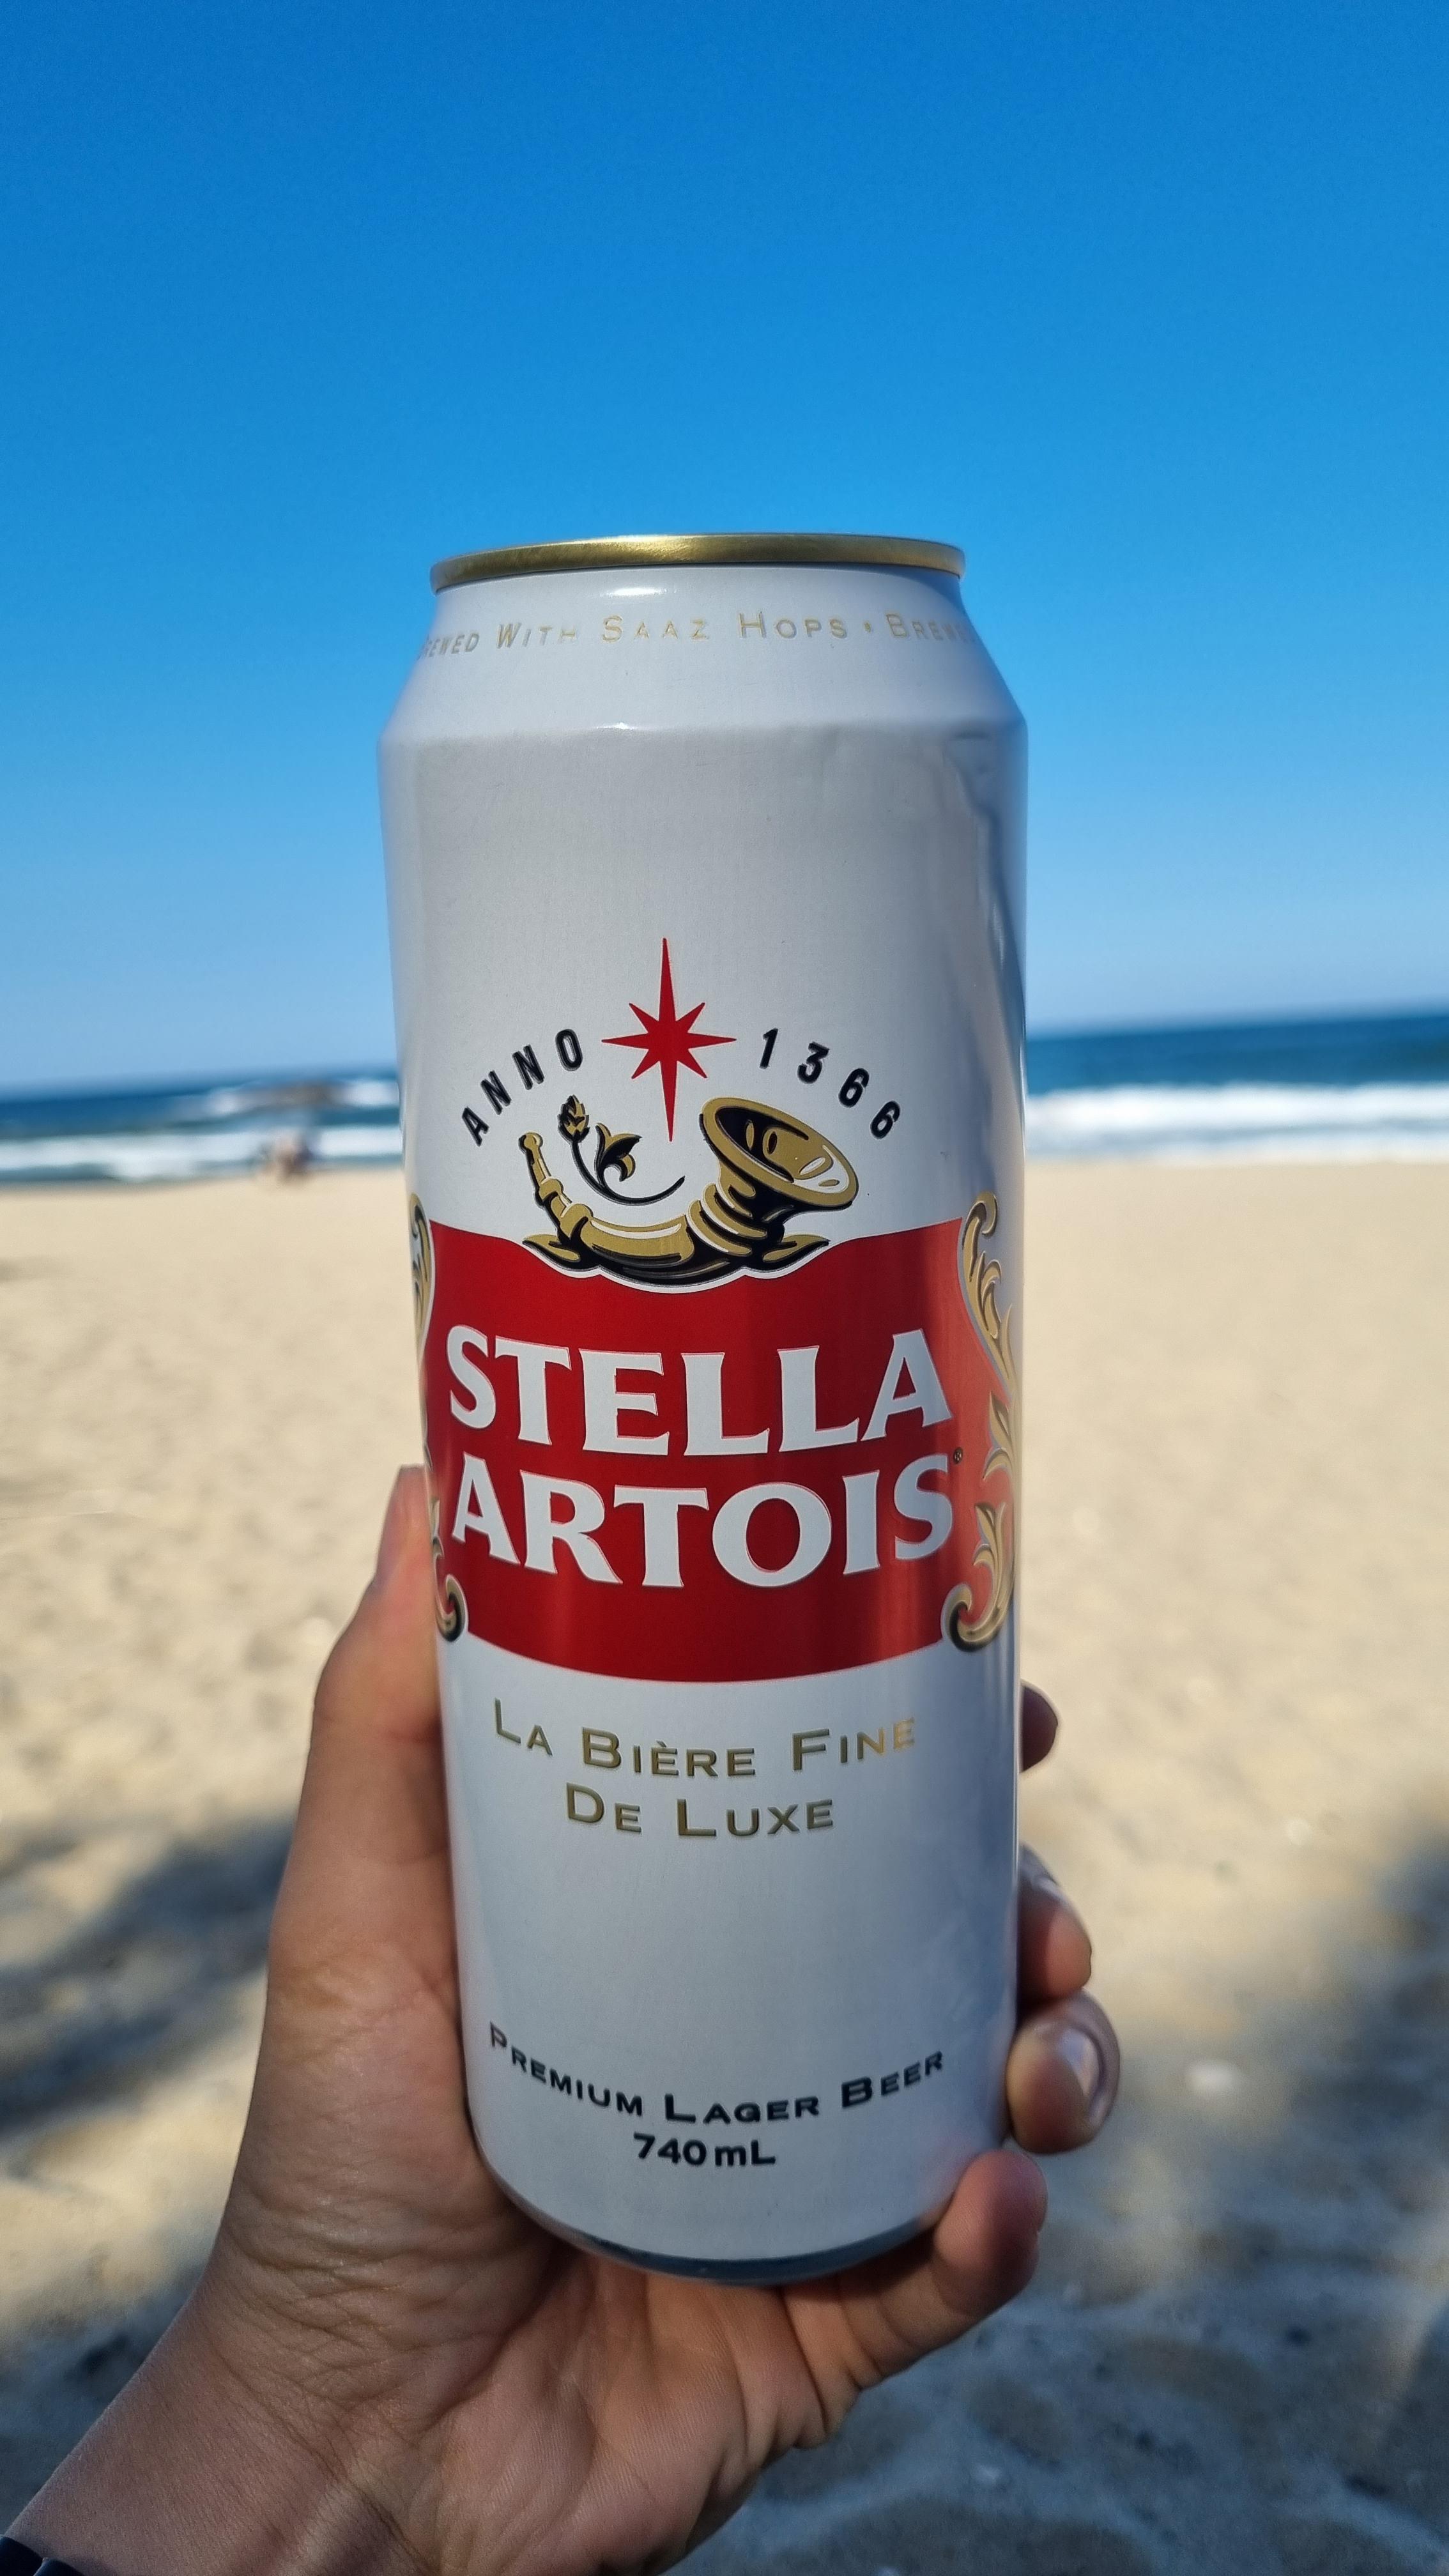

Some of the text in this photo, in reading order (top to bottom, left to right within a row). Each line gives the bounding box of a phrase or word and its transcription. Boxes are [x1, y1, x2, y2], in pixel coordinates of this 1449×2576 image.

[462, 1027, 901, 1146] ANNO 1366
[446, 1325, 953, 1456] STELLA
